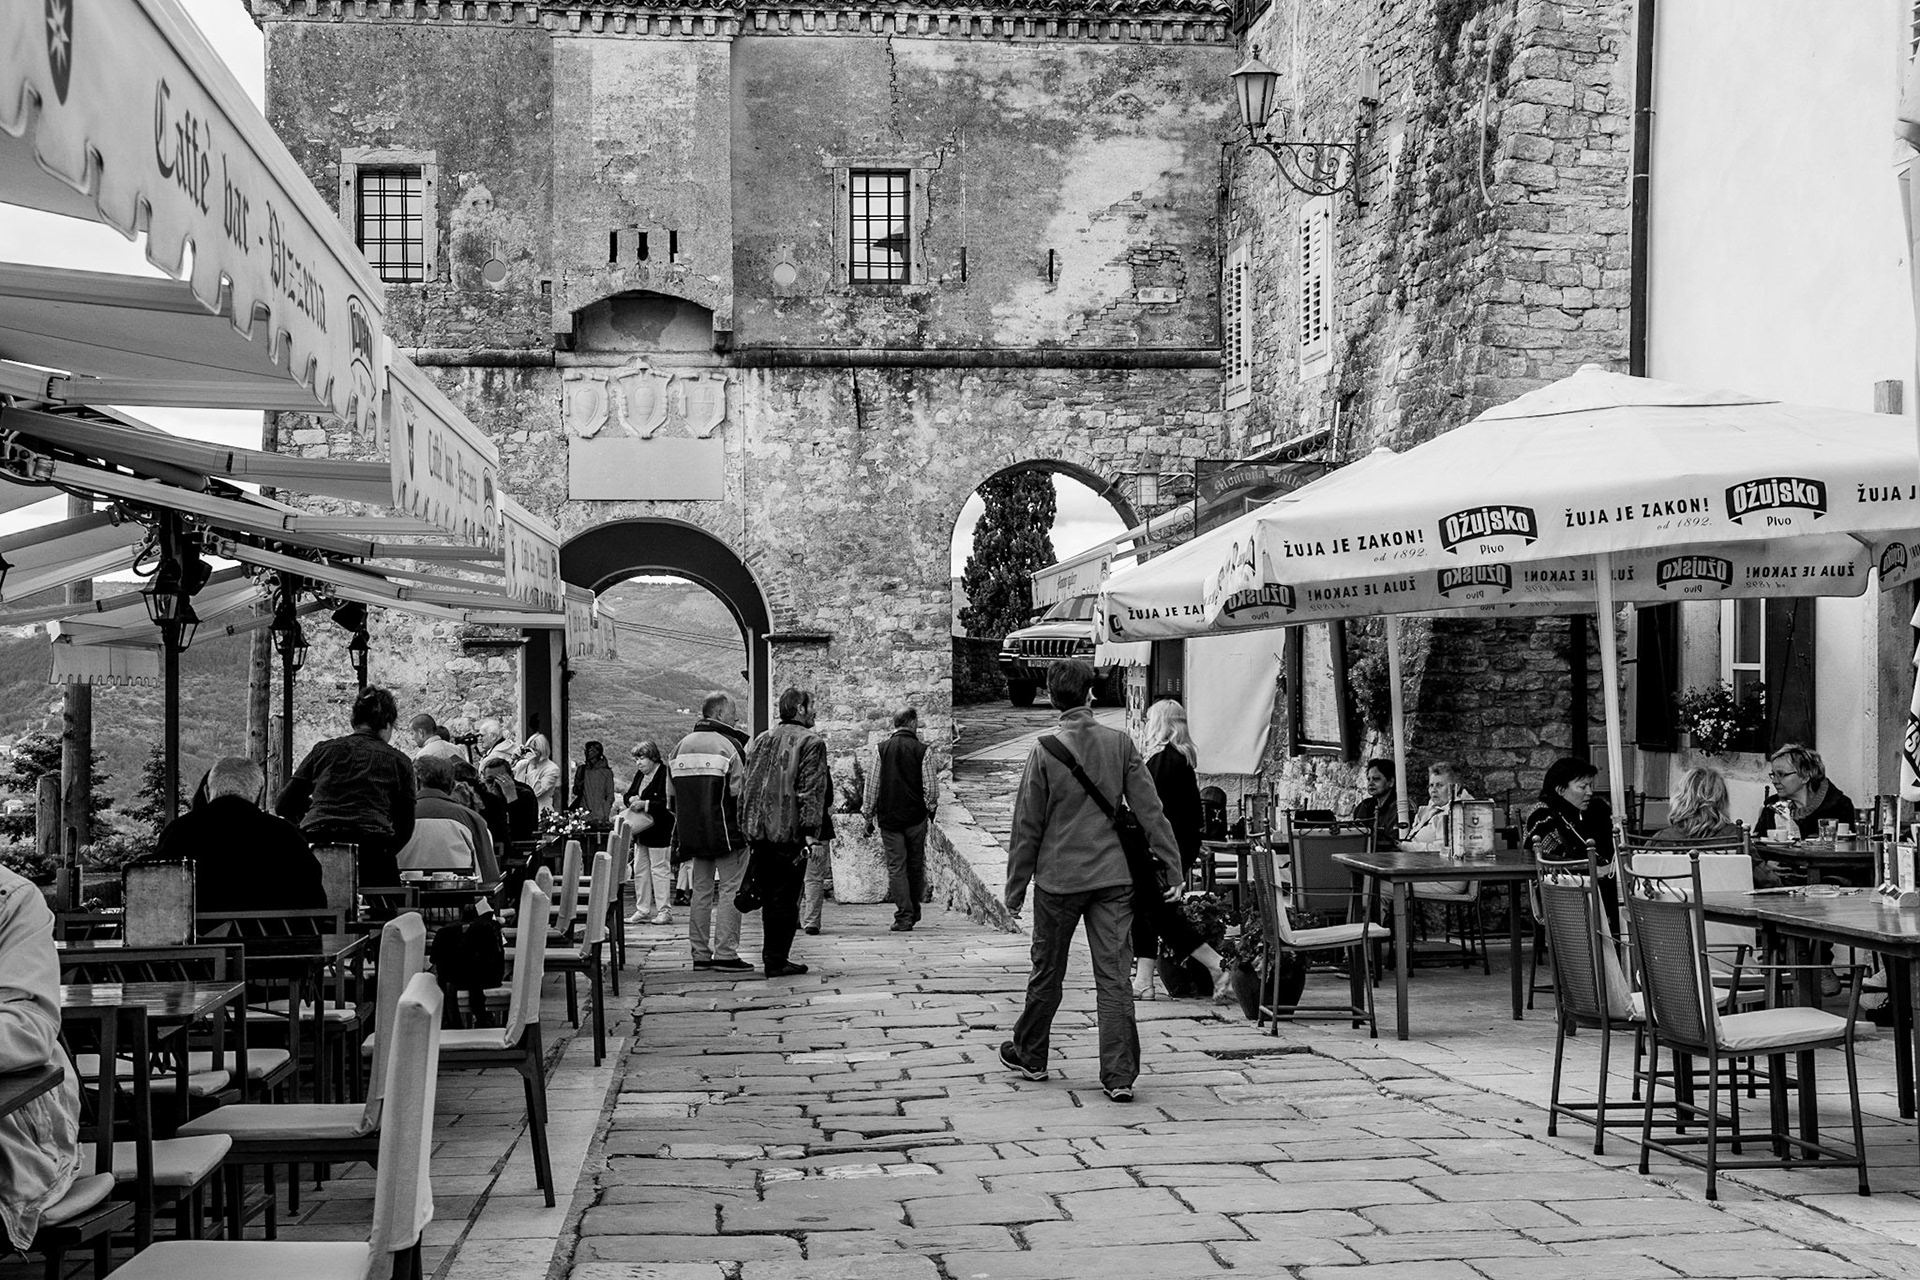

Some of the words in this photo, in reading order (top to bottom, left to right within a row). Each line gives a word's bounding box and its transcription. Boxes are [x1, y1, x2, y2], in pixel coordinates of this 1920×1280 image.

[222, 150, 250, 256] bar
[266, 200, 327, 335] Pizzeria
[1213, 470, 1266, 495] Montona
[1732, 479, 1820, 513] Ožujsko
[1857, 483, 1902, 503] ŽUJA
[1445, 507, 1530, 543] Ožujsko
[1565, 508, 1609, 528] ŽUJA
[1615, 505, 1635, 522] JE
[1641, 497, 1709, 518] ZAKON!
[1656, 520, 1671, 531] od
[1677, 516, 1713, 528] 1892.
[1283, 540, 1326, 558] ŽUJA
[1332, 538, 1351, 554] JE
[1357, 529, 1424, 551] ZAKON!
[1373, 552, 1387, 563] od
[1393, 547, 1428, 560] 1892.
[1127, 606, 1160, 621] ŽUJA
[1165, 606, 1179, 617] JE
